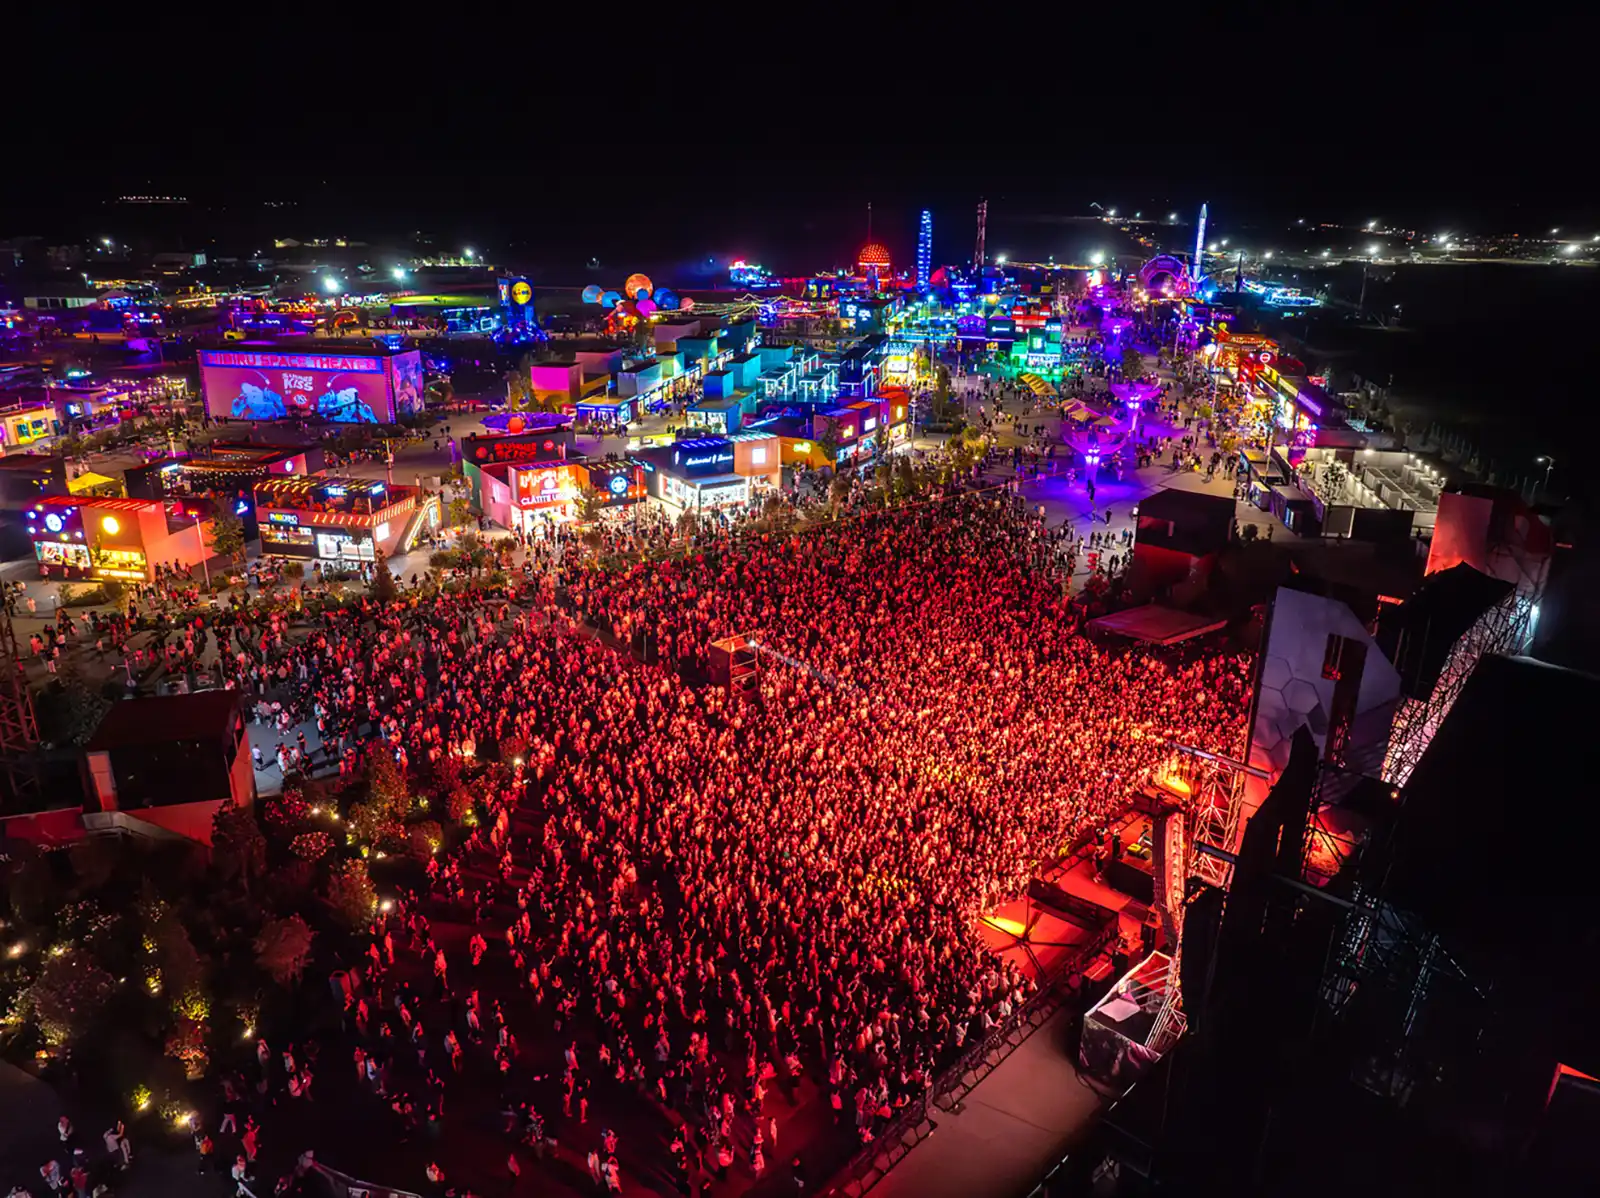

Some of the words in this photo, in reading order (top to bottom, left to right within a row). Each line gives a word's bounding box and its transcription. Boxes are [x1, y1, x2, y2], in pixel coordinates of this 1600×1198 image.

[261, 354, 307, 368] SPACE
[311, 356, 376, 370] THEATER
[283, 378, 313, 392] KISS
